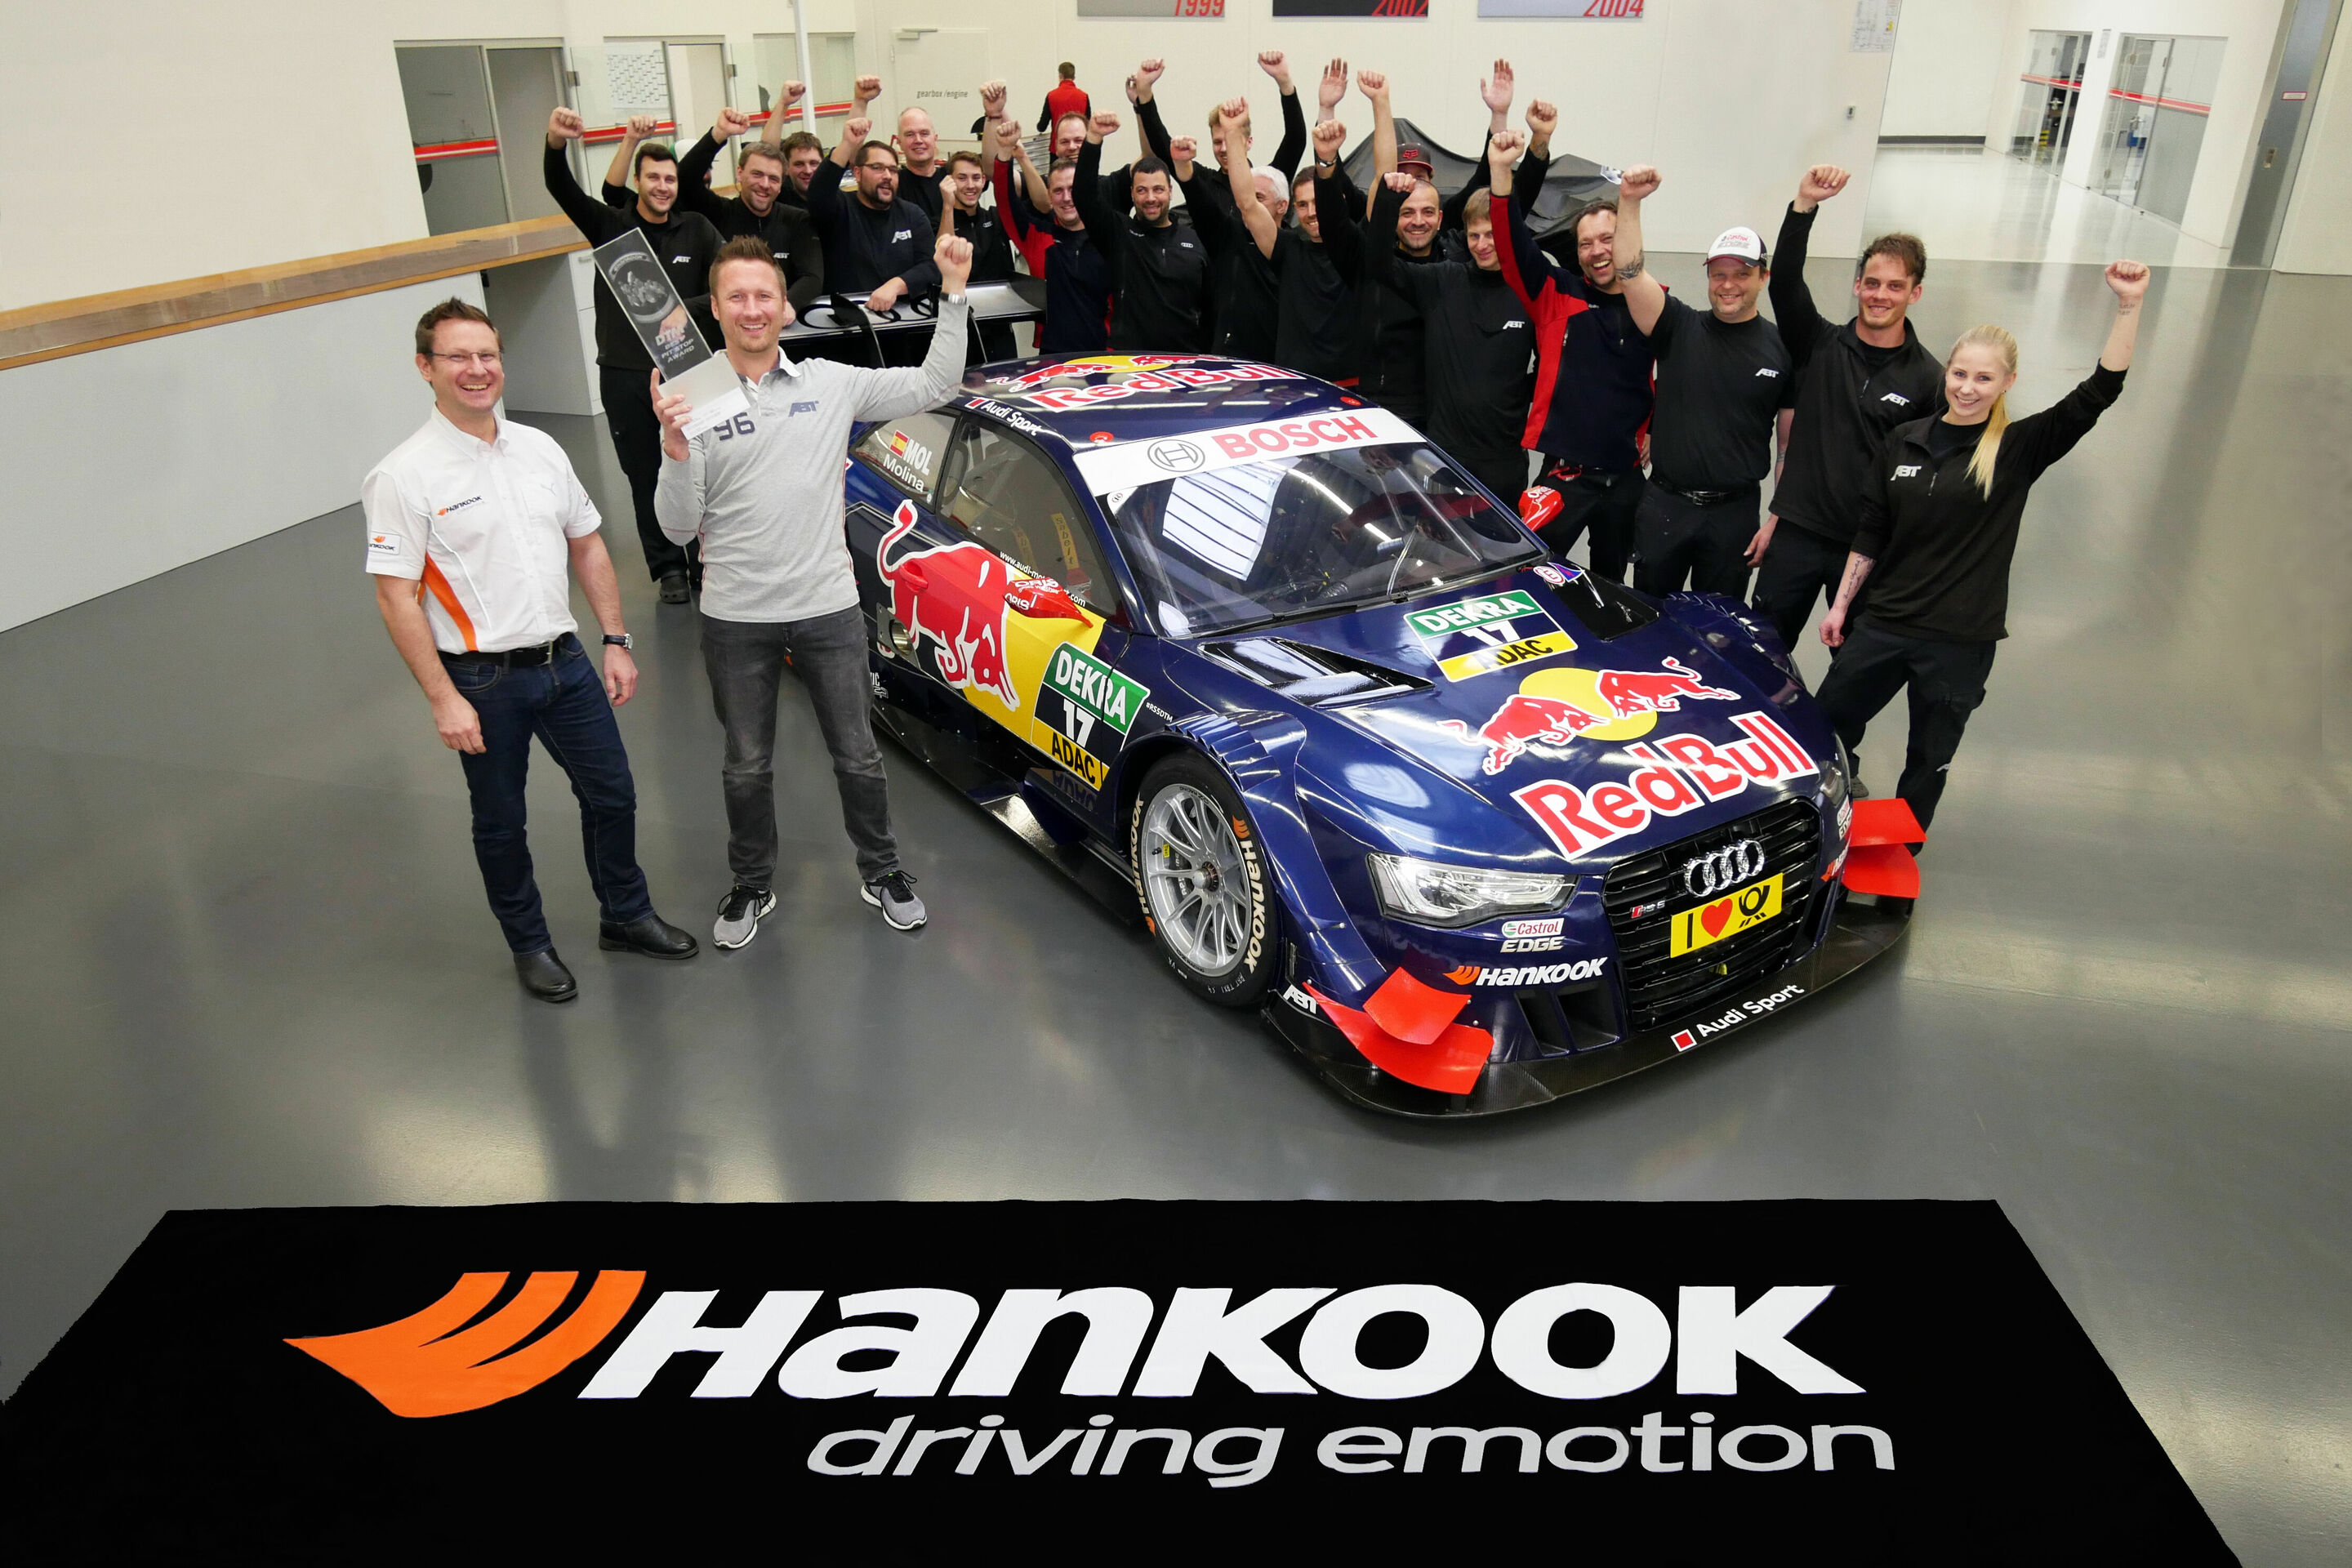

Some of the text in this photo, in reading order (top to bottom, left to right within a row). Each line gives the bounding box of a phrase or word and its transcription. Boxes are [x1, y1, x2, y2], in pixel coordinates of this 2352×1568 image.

[1583, 0, 1644, 16] 2004
[891, 229, 912, 243] ABT
[672, 256, 691, 264] ABT
[1503, 320, 1525, 329] ABT
[1756, 368, 1779, 378] ABT
[788, 400, 819, 417] ABT
[1880, 390, 1910, 406] ABT
[981, 400, 1041, 435] Audi Sport
[1212, 416, 1379, 460] BOSCH
[903, 439, 932, 476] MOL
[883, 453, 924, 492] Molina
[1890, 465, 1922, 481] ABT
[1413, 594, 1535, 632] DEKRA
[1462, 619, 1521, 648] 17
[1472, 639, 1553, 672] ADAC
[1054, 650, 1126, 725] DEKRA
[1063, 699, 1095, 748] 17
[1051, 732, 1096, 784] ADAC
[1517, 920, 1561, 937] Castrol
[1500, 936, 1565, 952] EDGE
[1283, 985, 1316, 1013] ABT
[1698, 985, 1804, 1036] Audi Sport
[808, 1412, 1895, 1487] driving emotion
